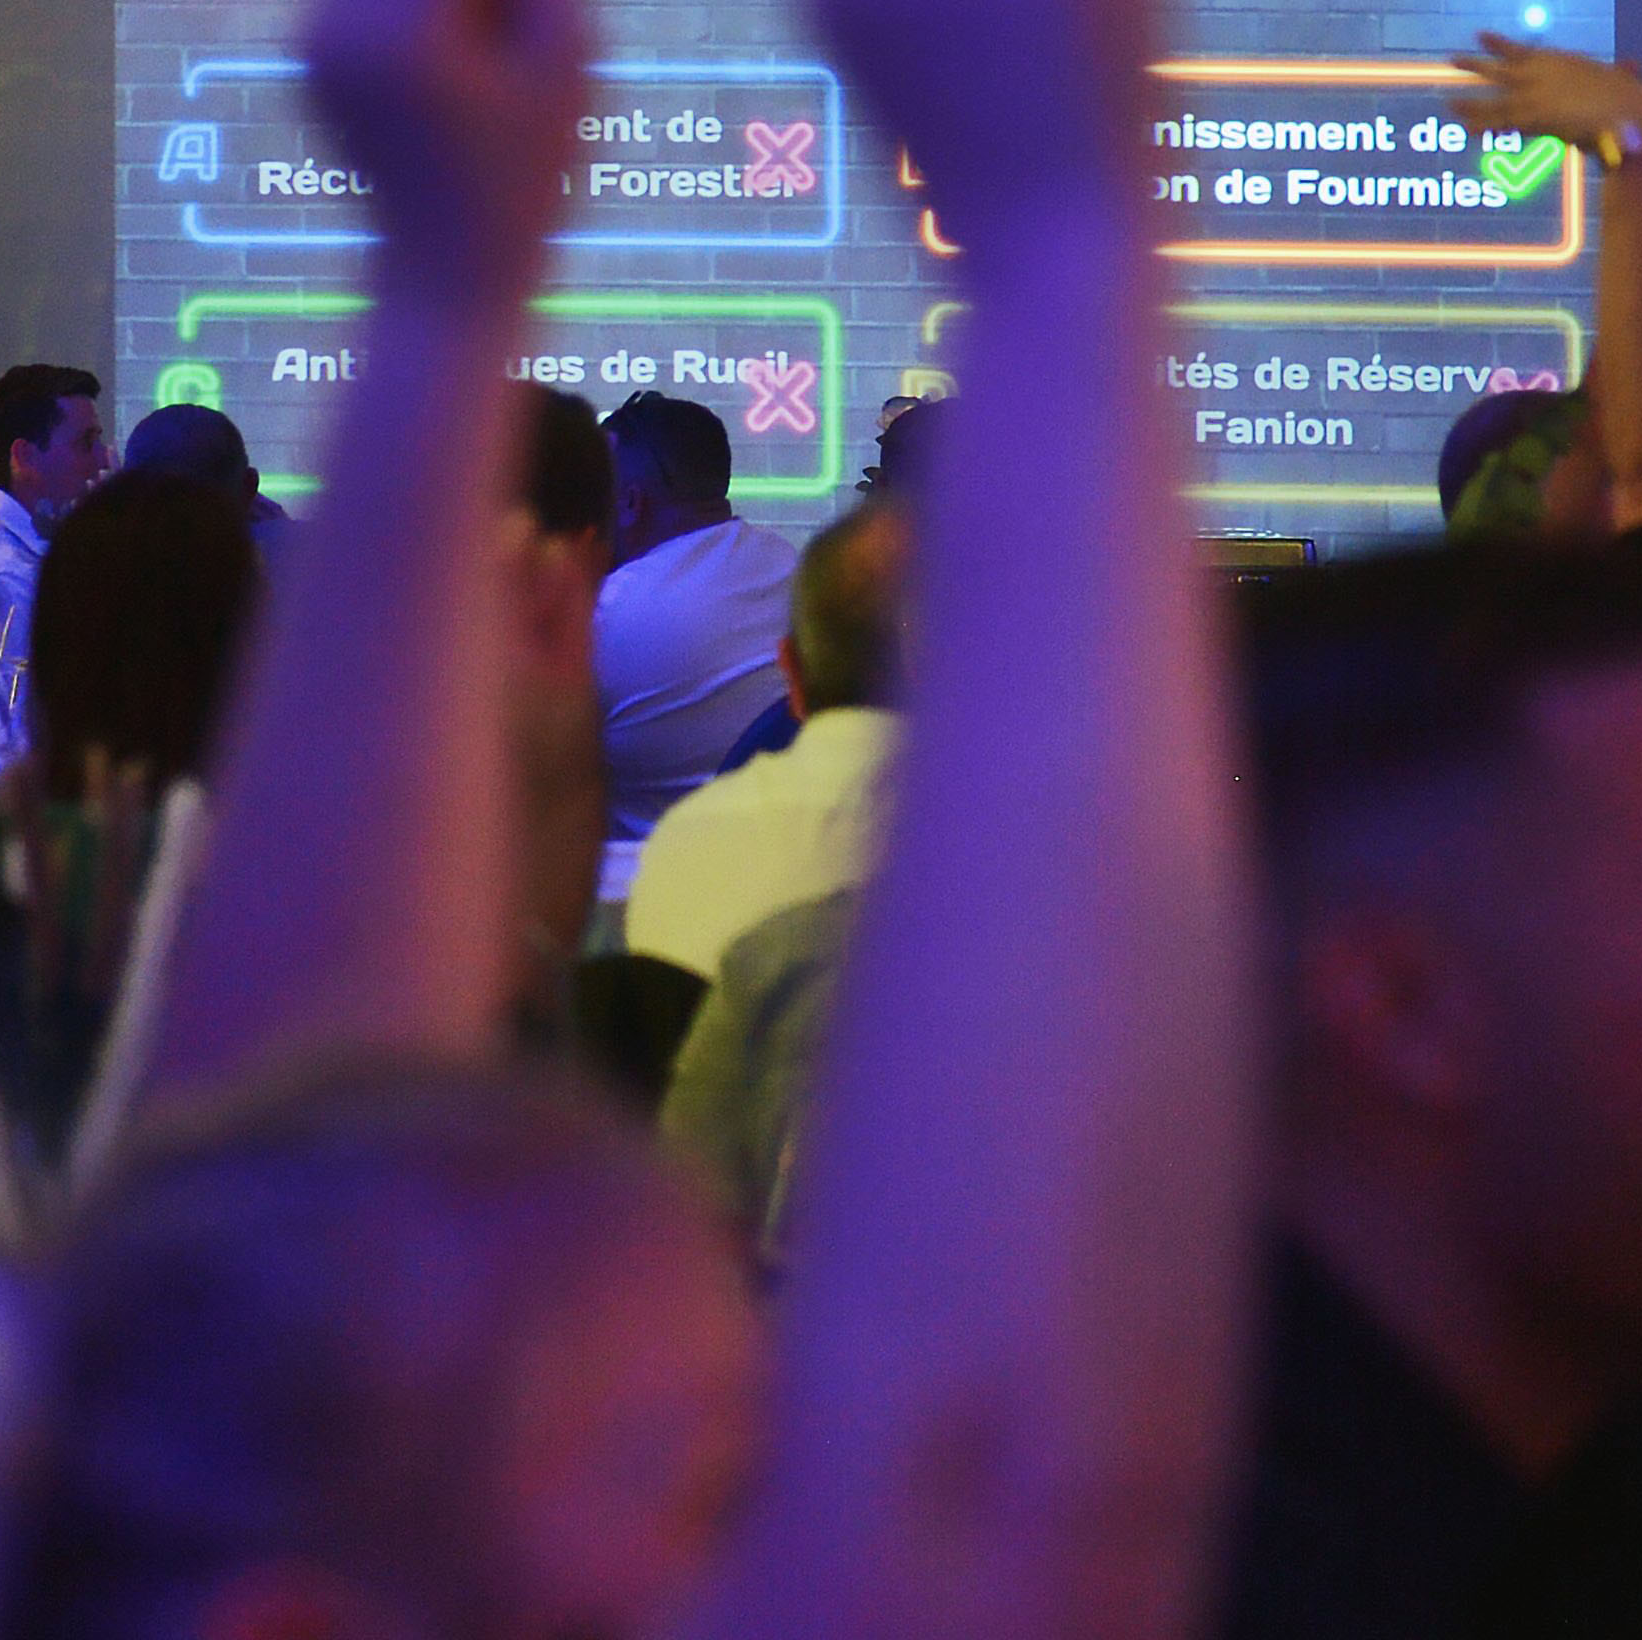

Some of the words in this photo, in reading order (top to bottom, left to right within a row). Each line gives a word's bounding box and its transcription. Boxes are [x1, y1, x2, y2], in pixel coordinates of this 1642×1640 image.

[665, 108, 724, 144] de
[1408, 115, 1468, 153] de
[1213, 167, 1273, 206] de
[1286, 168, 1509, 209] Fourmies
[599, 348, 658, 384] de
[1253, 355, 1312, 391] de
[1195, 410, 1354, 446] Fanion
